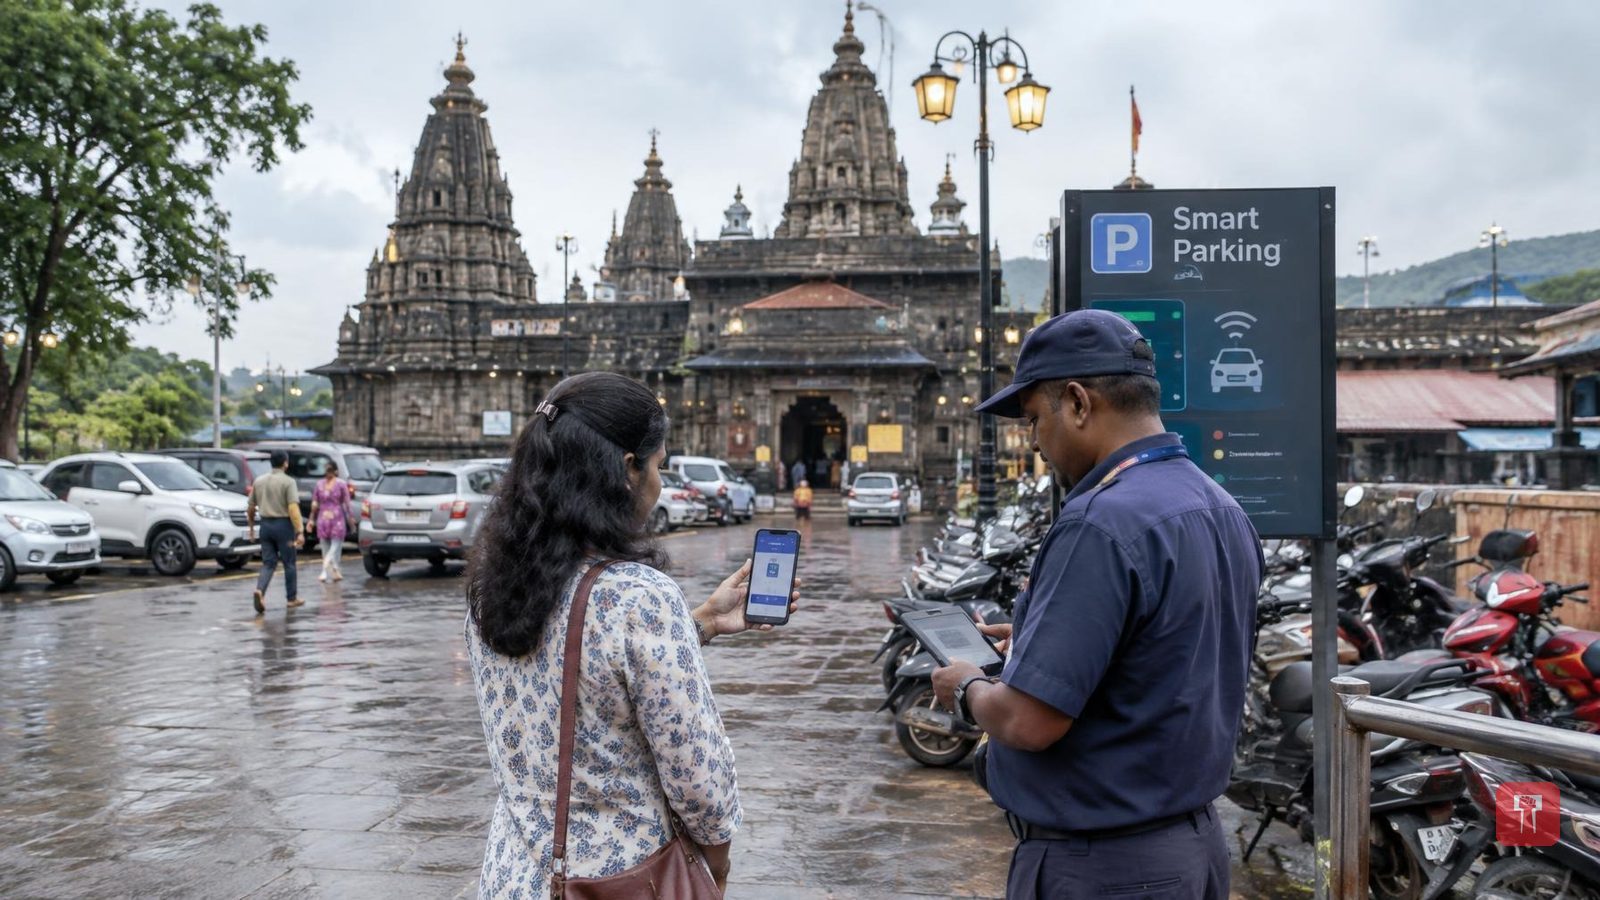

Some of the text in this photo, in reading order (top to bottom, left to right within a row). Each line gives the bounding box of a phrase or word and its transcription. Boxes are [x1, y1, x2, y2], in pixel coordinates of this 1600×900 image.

[1173, 206, 1260, 231] Smart
[1106, 223, 1139, 265] P
[1173, 238, 1281, 267] Parking
